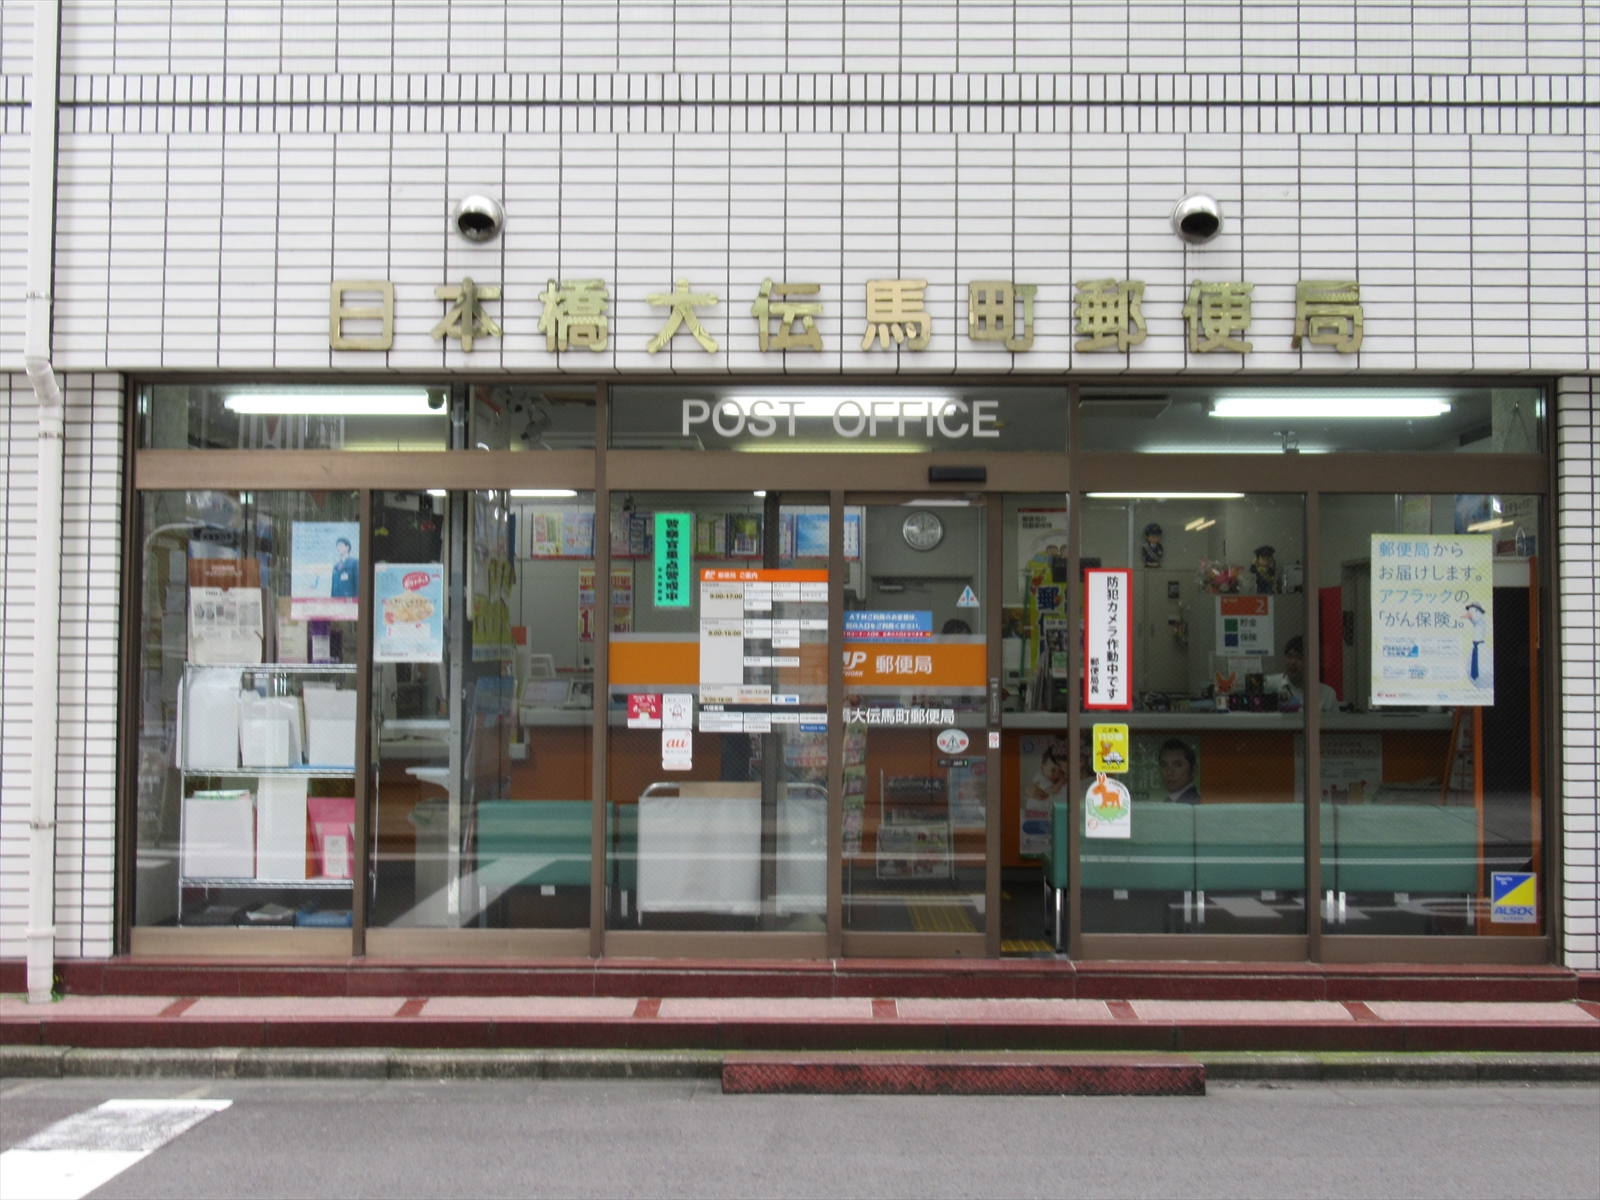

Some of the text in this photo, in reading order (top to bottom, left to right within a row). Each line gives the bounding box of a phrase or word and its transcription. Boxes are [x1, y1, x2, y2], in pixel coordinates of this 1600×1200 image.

[330, 277, 1363, 353] 日本橋大伝馬町郵便局
[682, 399, 1000, 437] POST OFFICE
[1379, 541, 1464, 558] 郵便局から
[1379, 564, 1482, 582] お届けします。
[1380, 588, 1470, 604] アフラックの
[1256, 599, 1266, 614] 2
[1379, 610, 1465, 629] 「がん保険」。
[1107, 576, 1119, 700] 防犯カメラ作動中です
[876, 655, 932, 675] 郵便局
[1494, 906, 1534, 916] ALSOK
